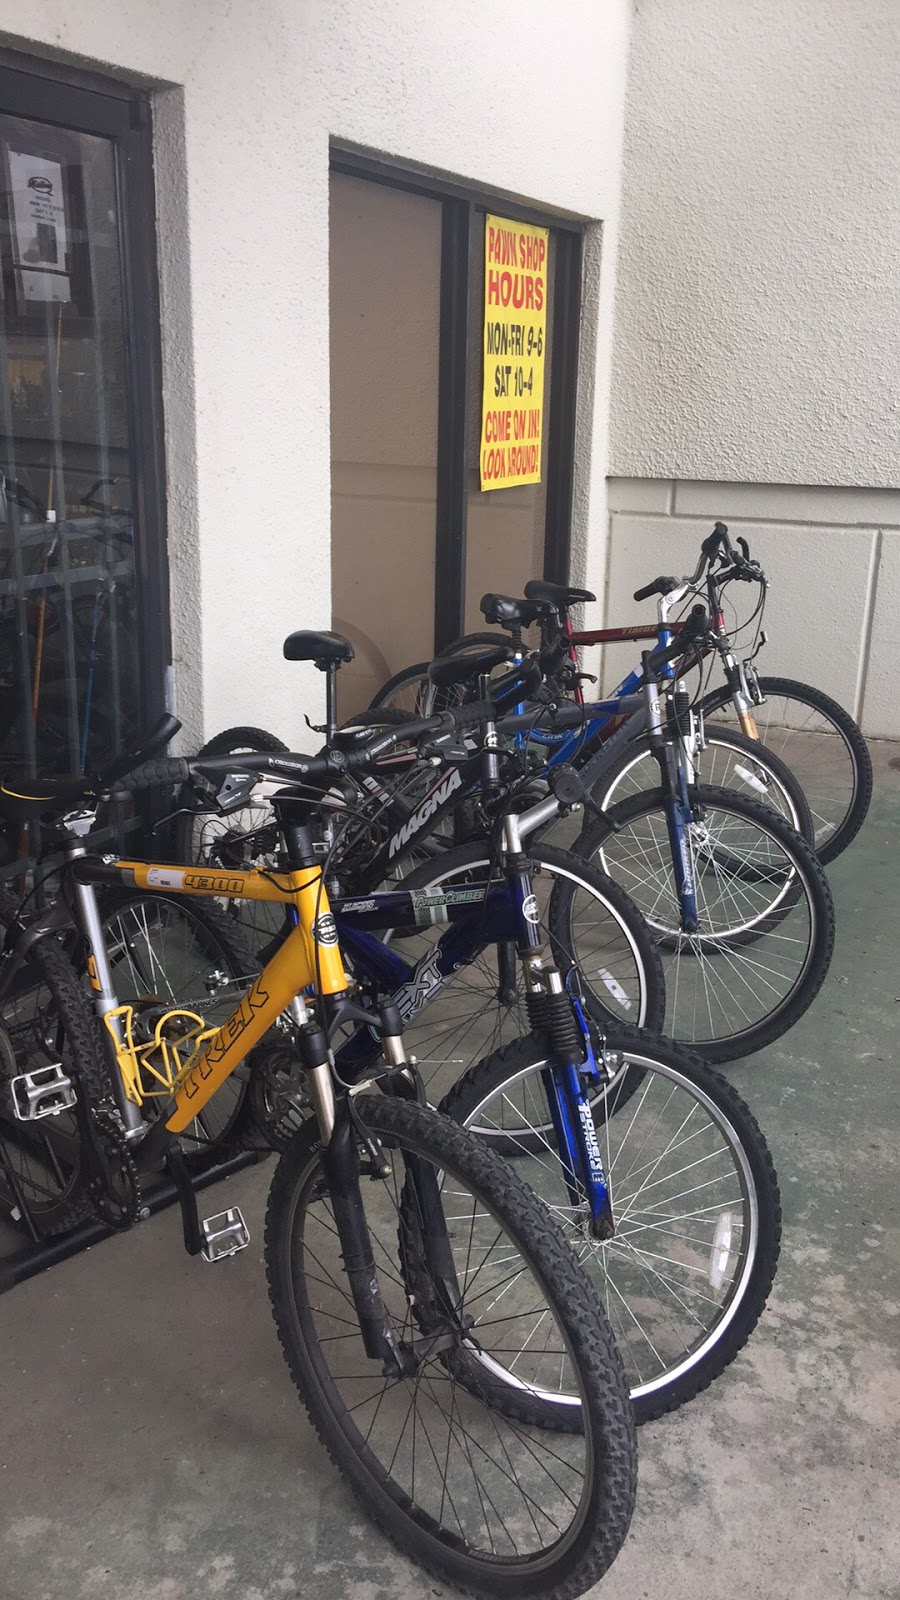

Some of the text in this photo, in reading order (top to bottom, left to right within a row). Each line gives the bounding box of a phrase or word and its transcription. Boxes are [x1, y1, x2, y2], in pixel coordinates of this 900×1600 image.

[488, 226, 545, 272] PAWN SHOP
[488, 269, 543, 311] HOURS
[487, 321, 543, 358] MON-FRI 9-6
[494, 366, 533, 397] SAT 10-4
[485, 408, 540, 444] COME ON IN!
[483, 444, 540, 481] LOOK AROUND!
[388, 768, 463, 859] MAGNA
[184, 874, 245, 894] 4300
[380, 948, 443, 1032] EXT
[182, 976, 269, 1099] TREK
